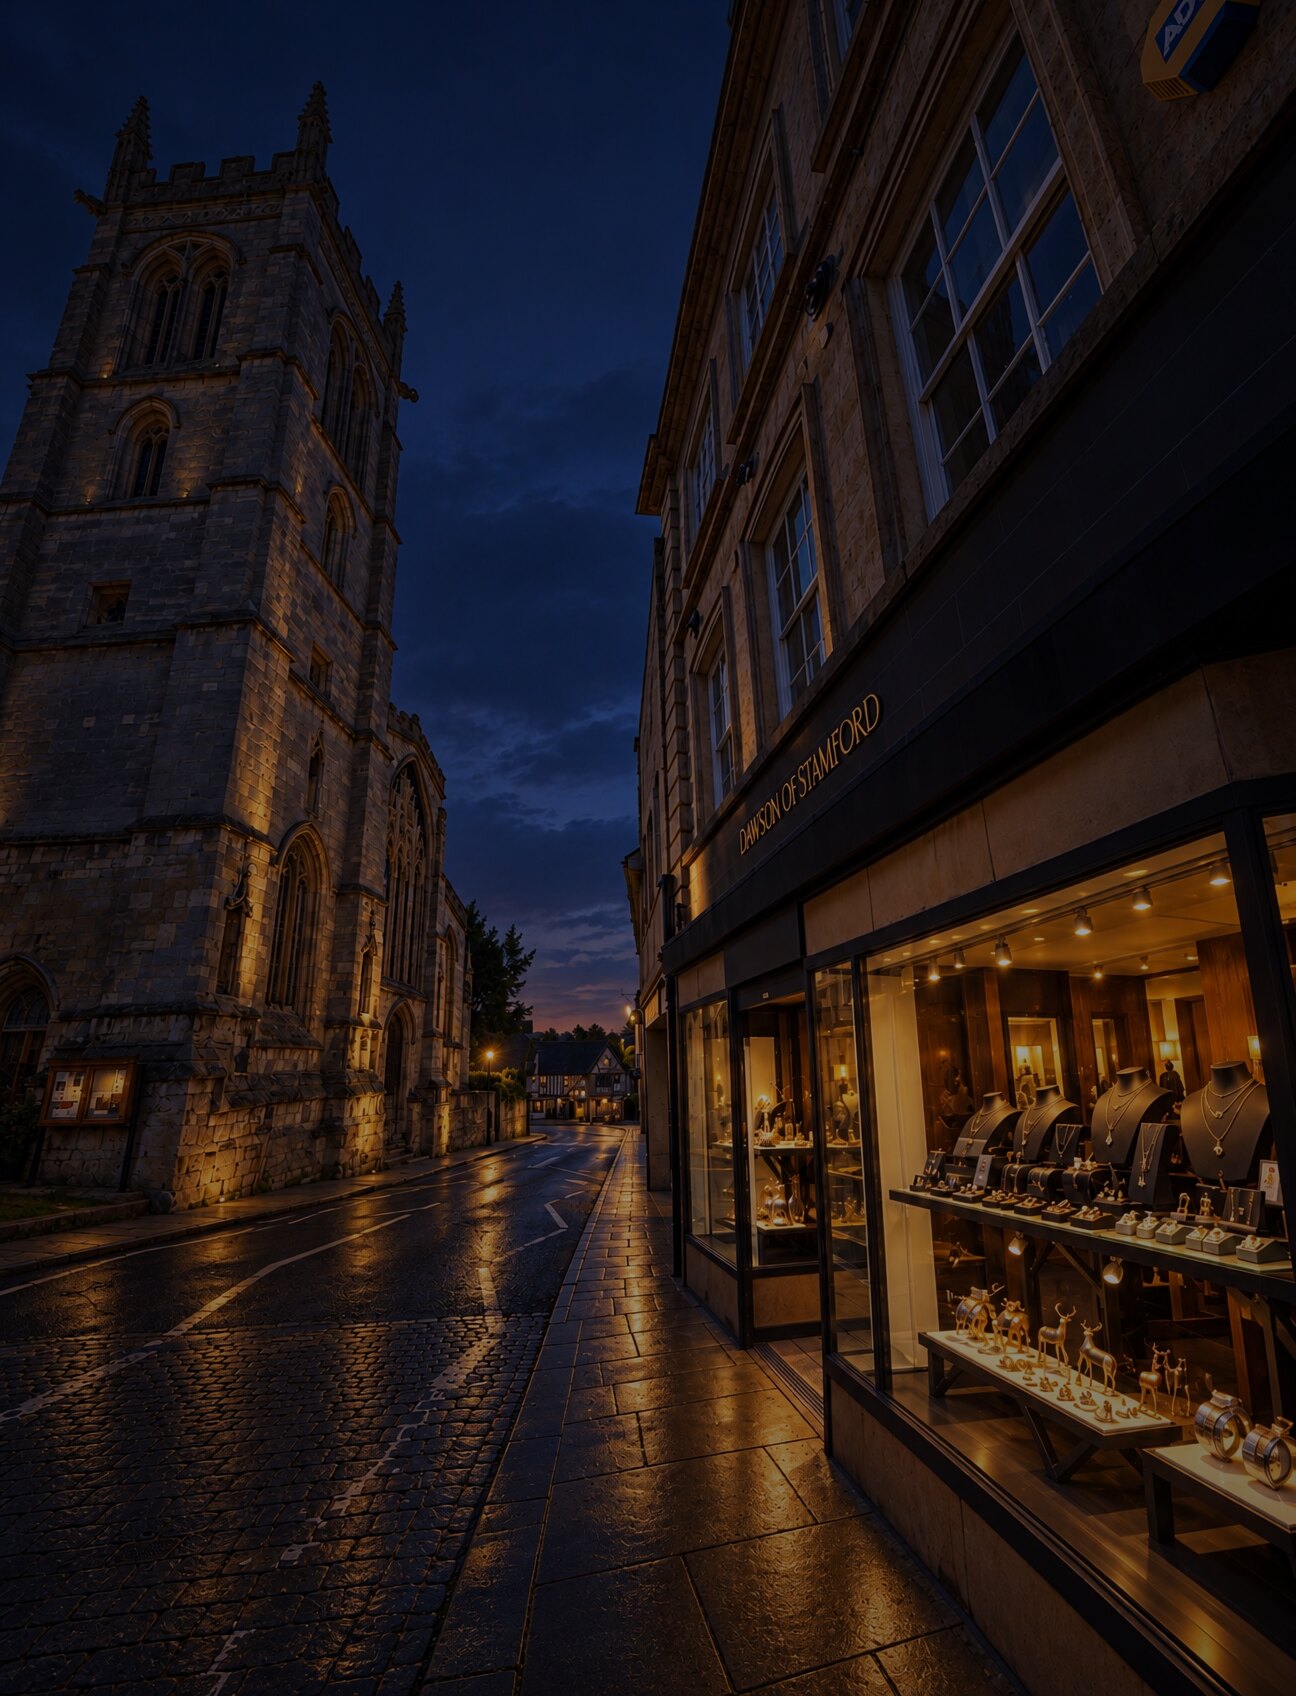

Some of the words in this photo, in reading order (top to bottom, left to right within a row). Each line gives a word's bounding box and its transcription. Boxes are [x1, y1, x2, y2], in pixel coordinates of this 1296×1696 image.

[1163, 0, 1199, 57] AD
[739, 792, 782, 855] DAWSON
[781, 775, 797, 812] OF
[797, 693, 881, 798] STAMFORD
